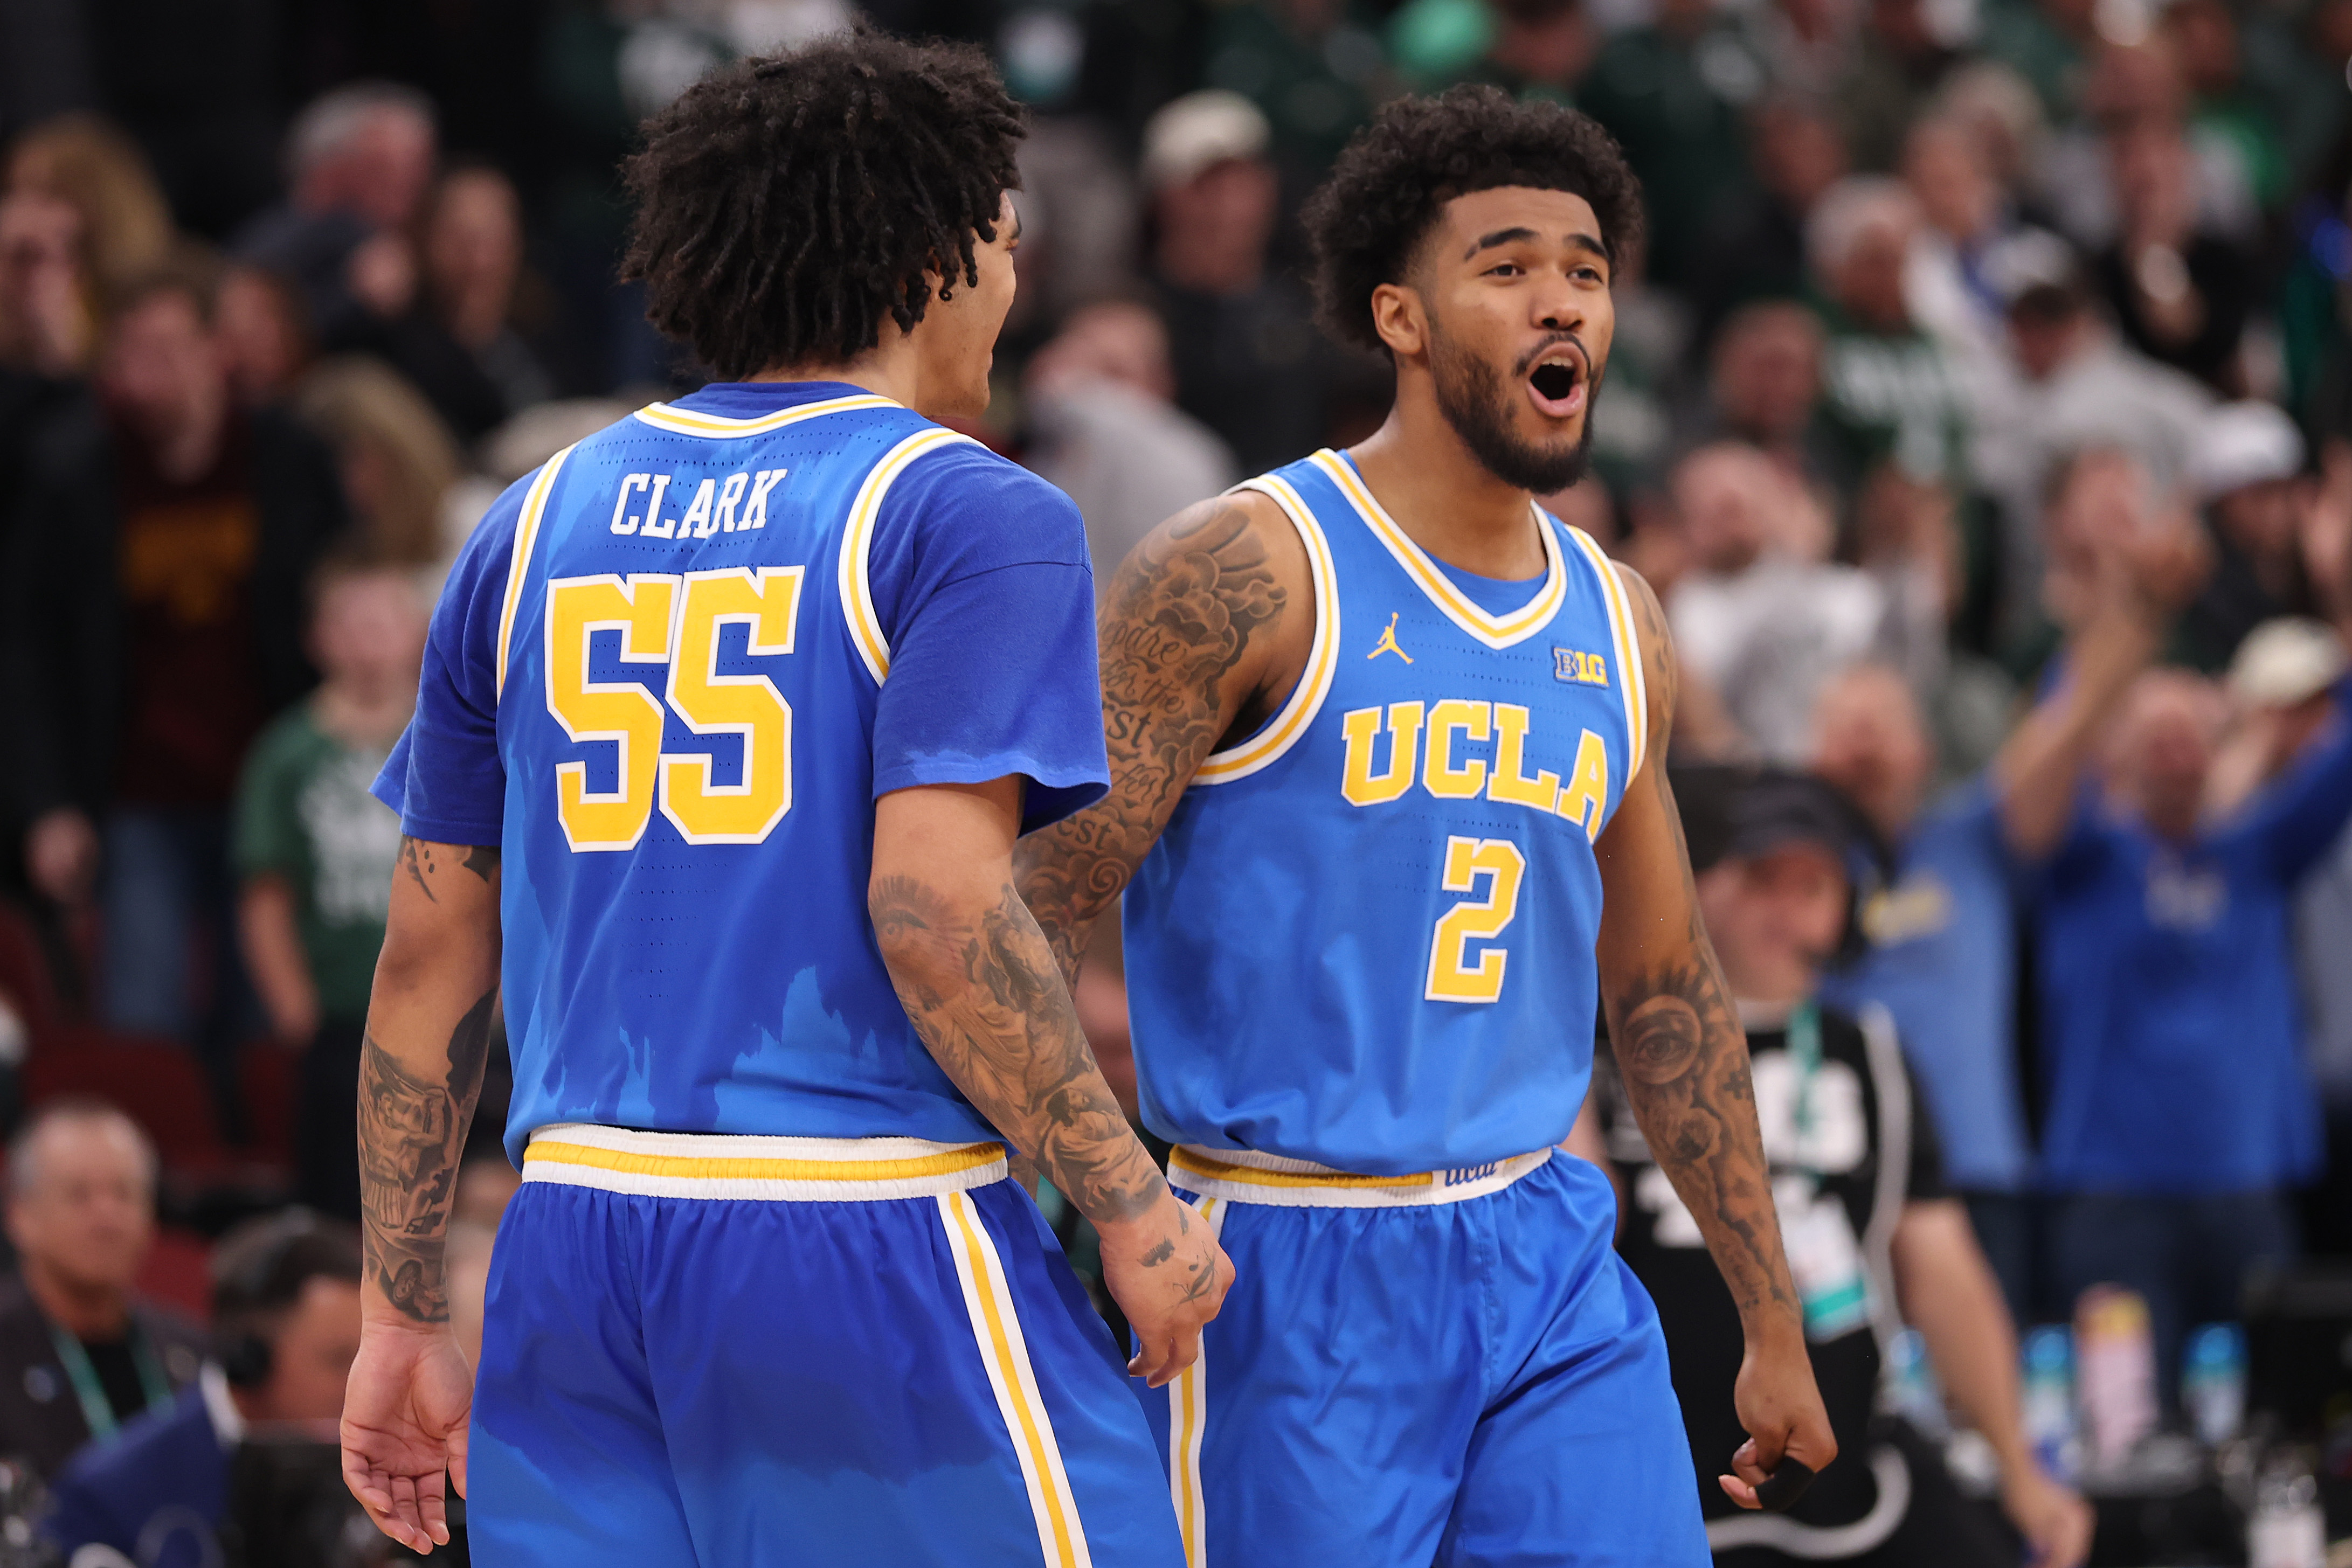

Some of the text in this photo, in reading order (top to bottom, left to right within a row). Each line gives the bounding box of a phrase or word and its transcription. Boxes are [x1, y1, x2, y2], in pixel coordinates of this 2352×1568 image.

[610, 468, 788, 539] CLARK
[544, 566, 805, 854] 55
[1341, 699, 1609, 845] UCLA
[1056, 815, 1112, 850] est
[1424, 835, 1526, 1003] 2
